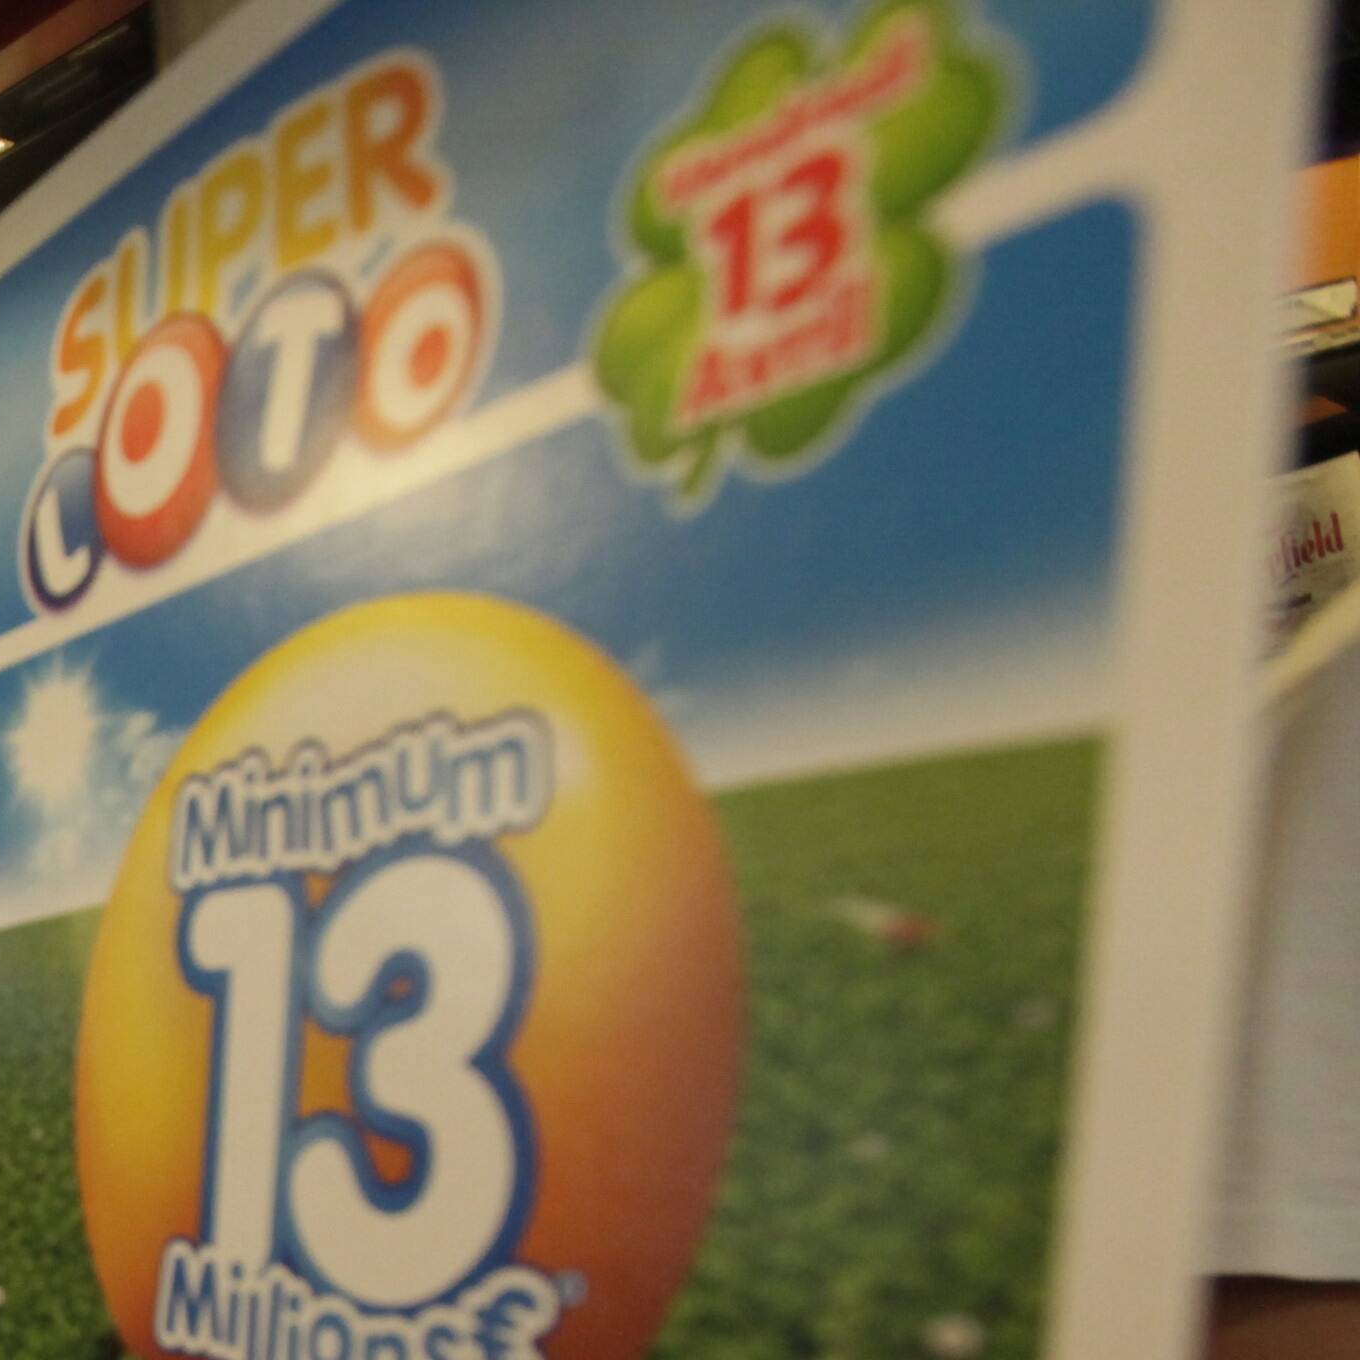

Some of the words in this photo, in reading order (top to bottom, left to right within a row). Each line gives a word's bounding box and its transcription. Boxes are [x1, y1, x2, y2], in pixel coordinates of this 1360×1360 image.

[48, 56, 442, 440] SUPER
[710, 148, 846, 320] 13
[26, 238, 485, 612] LOTO
[175, 710, 548, 890] Minimum
[180, 848, 530, 1308] 13
